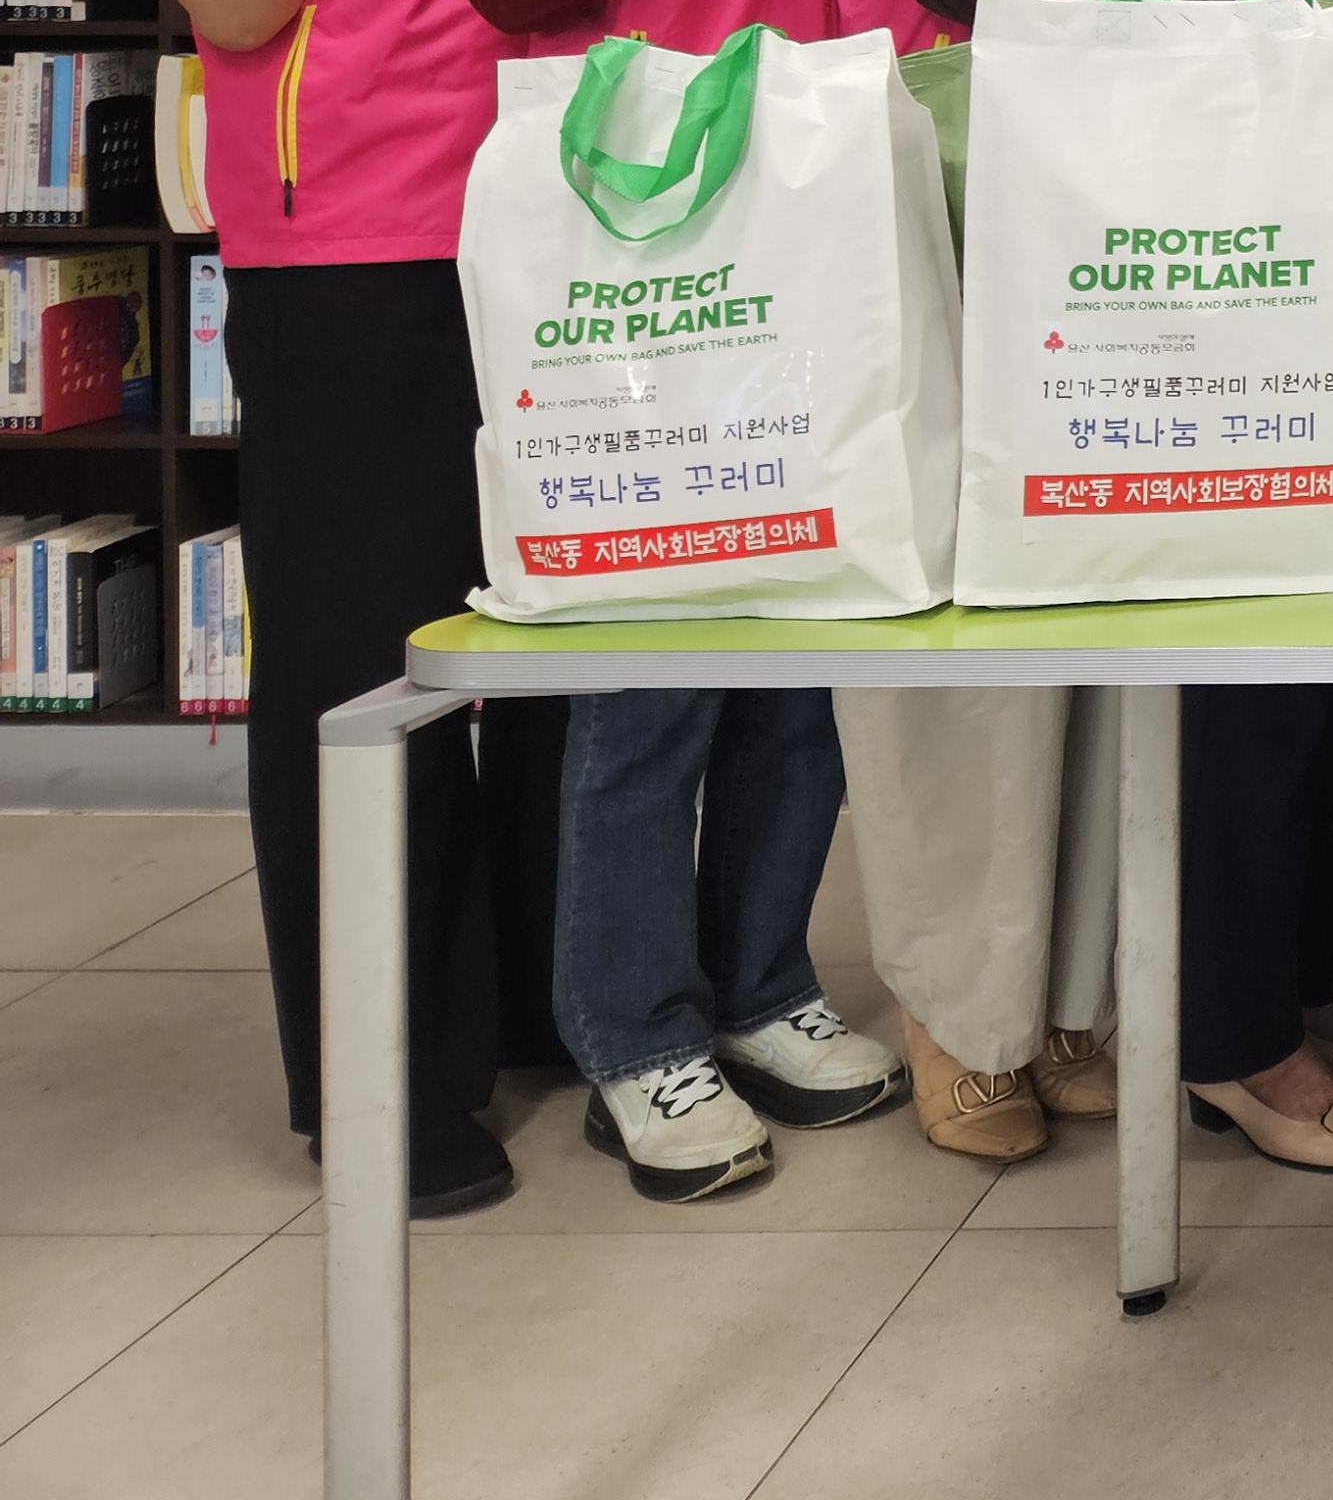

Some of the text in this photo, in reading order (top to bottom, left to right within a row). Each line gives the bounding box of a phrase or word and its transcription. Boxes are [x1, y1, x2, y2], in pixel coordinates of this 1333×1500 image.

[14, 7, 22, 18] 3
[56, 7, 65, 18] 3
[9, 213, 17, 223] 3
[69, 213, 77, 223] 3
[1104, 225, 1281, 256] PROTECT
[567, 262, 736, 310] PROTECT
[1068, 259, 1315, 292] OUR PLANET
[1065, 296, 1318, 312] BRING YOUR OWN BAG AND SAVE THE EARTH
[533, 294, 774, 349] OUR PLANET
[531, 333, 778, 370] BRING YOUR OWN BAG AND SAVE THE EARTH
[1042, 375, 1248, 399] 1인가구생필품꾸러미
[10, 417, 18, 429] 3
[28, 417, 36, 429] 3
[1068, 412, 1316, 450] 행복나눔 꾸러미
[516, 412, 812, 460] 1인가구생필품꾸러미 지원사업
[538, 457, 785, 509] 행복나눔 꾸러미
[1040, 478, 1113, 508] 복산동
[527, 517, 820, 572] 복산동 지역사회보장협의체
[2, 699, 12, 710] 4
[35, 699, 45, 710] 4
[76, 699, 85, 710] 4
